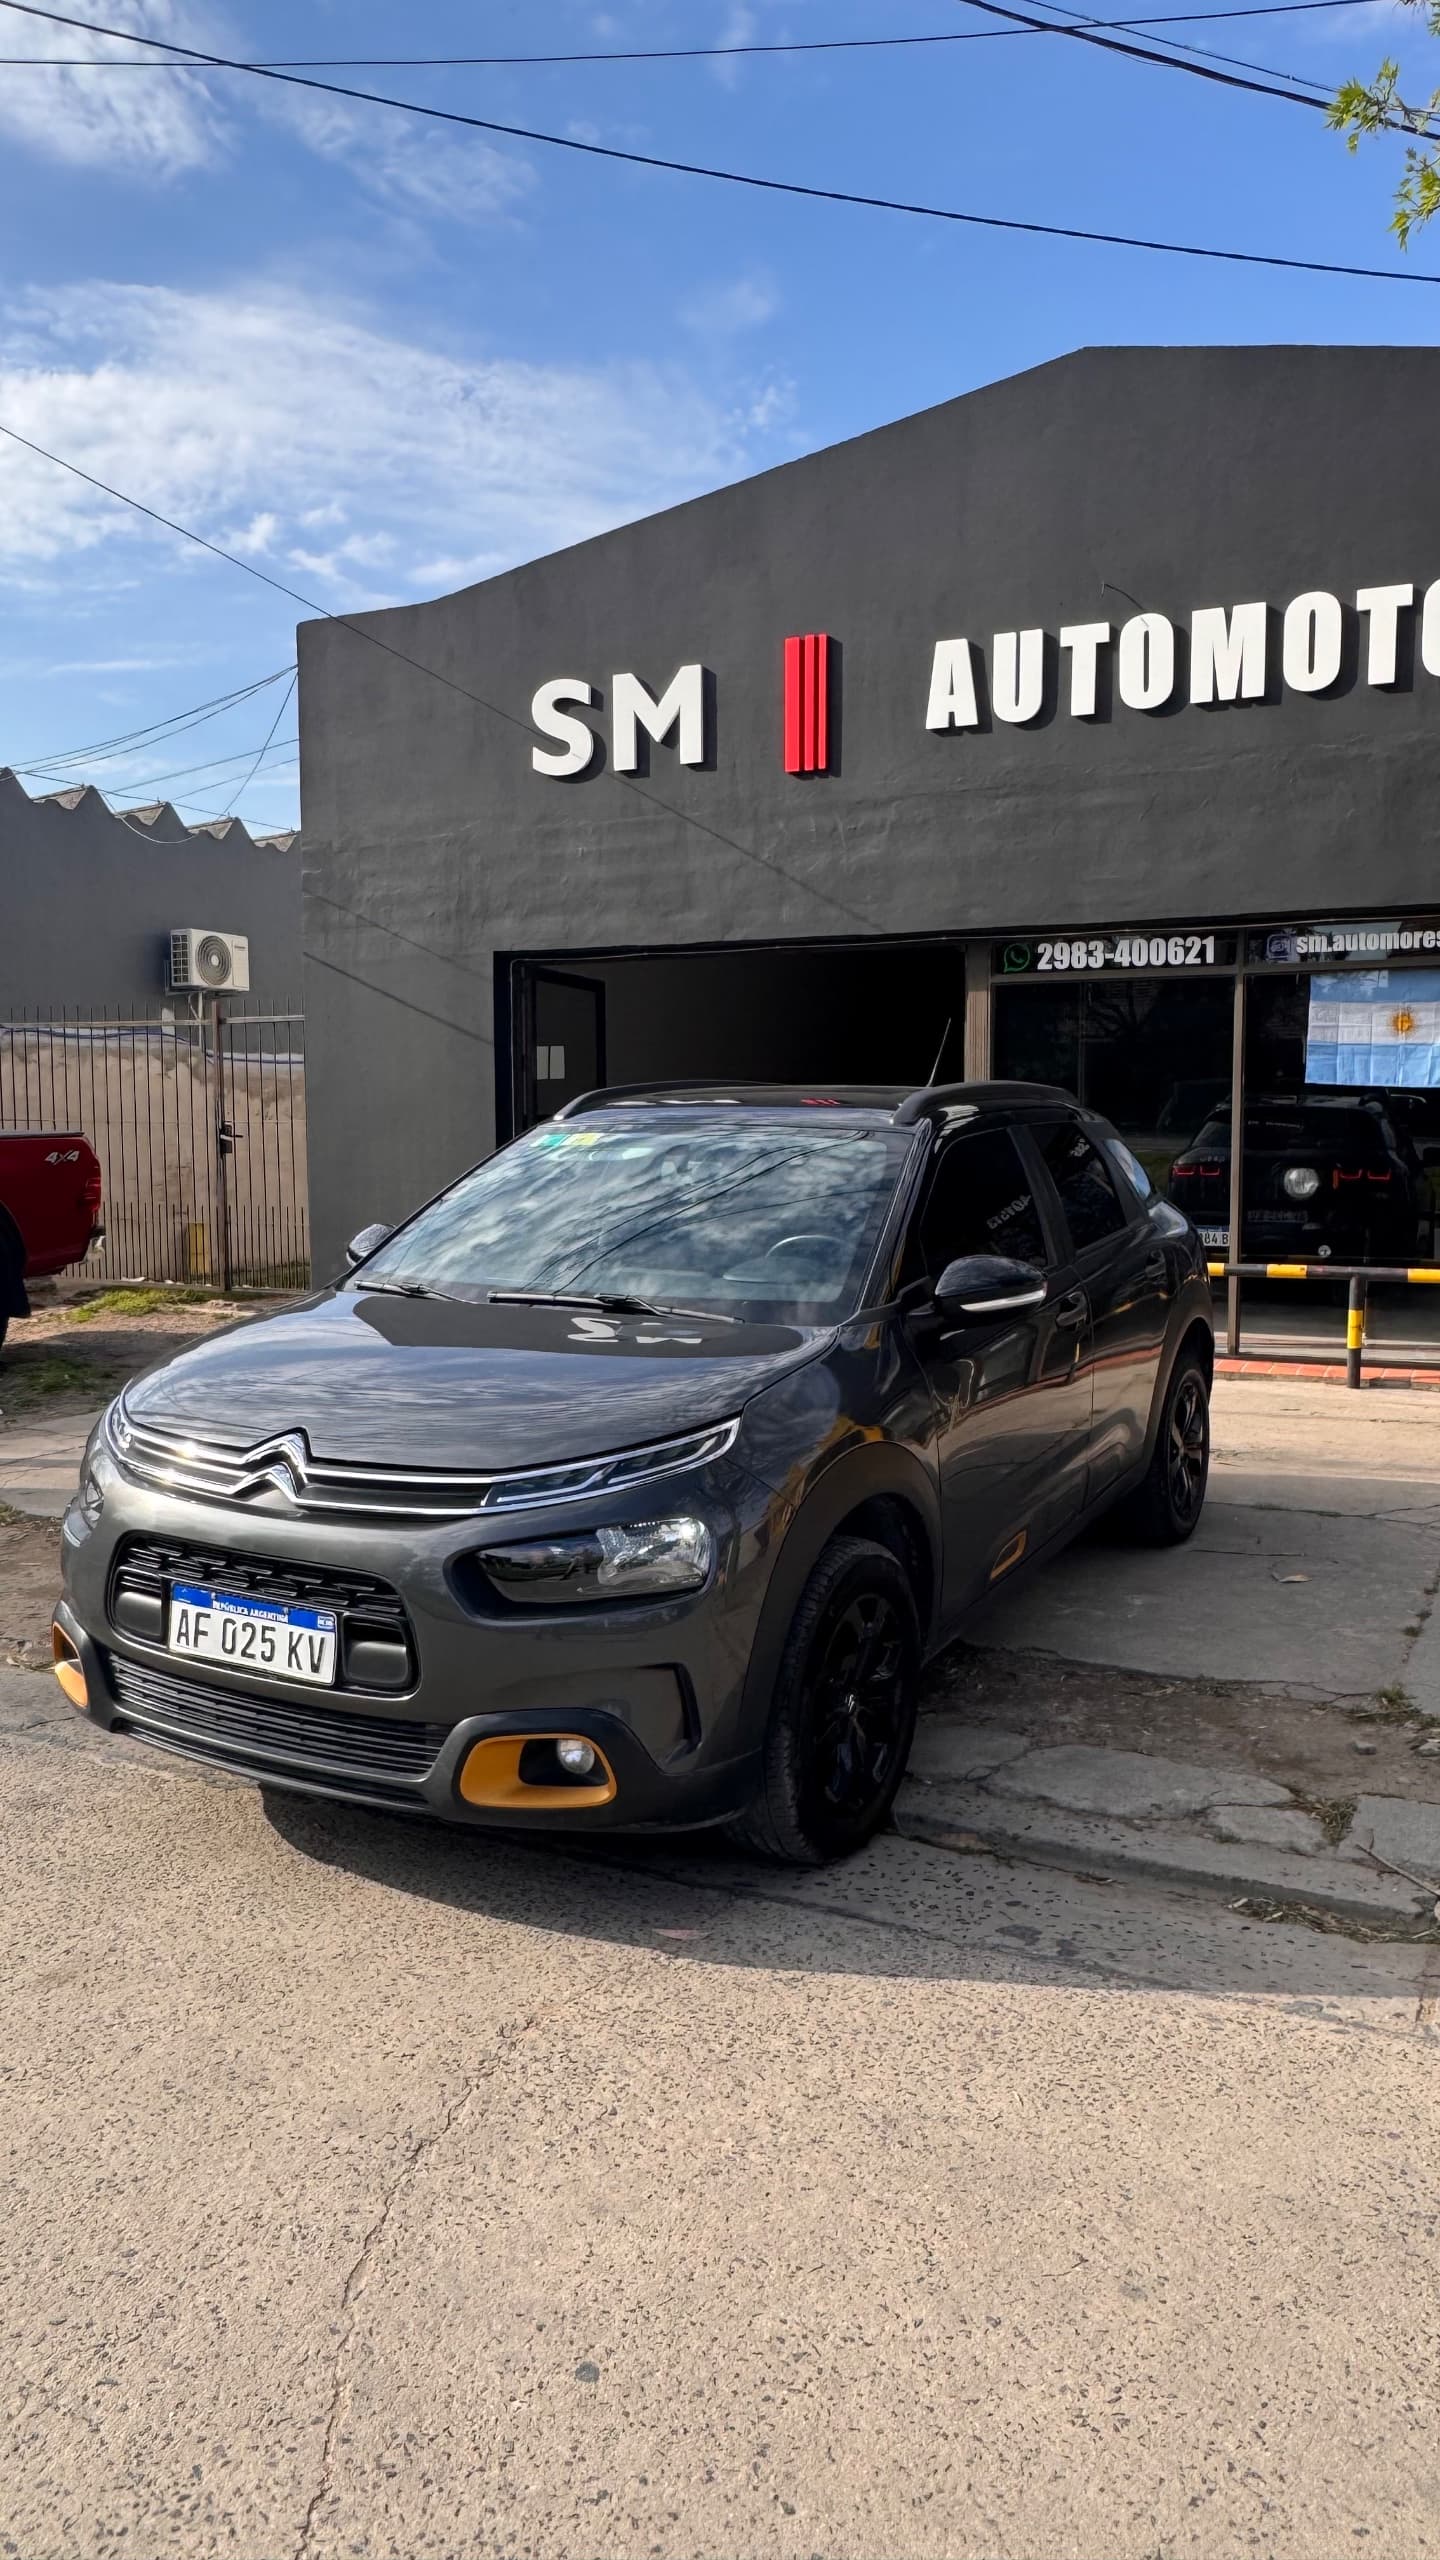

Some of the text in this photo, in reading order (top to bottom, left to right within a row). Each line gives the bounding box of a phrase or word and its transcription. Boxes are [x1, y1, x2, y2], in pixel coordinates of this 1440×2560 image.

[532, 664, 703, 776] SM
[1037, 936, 1215, 970] 2983-400621
[176, 1609, 326, 1674] AF 025 KV
